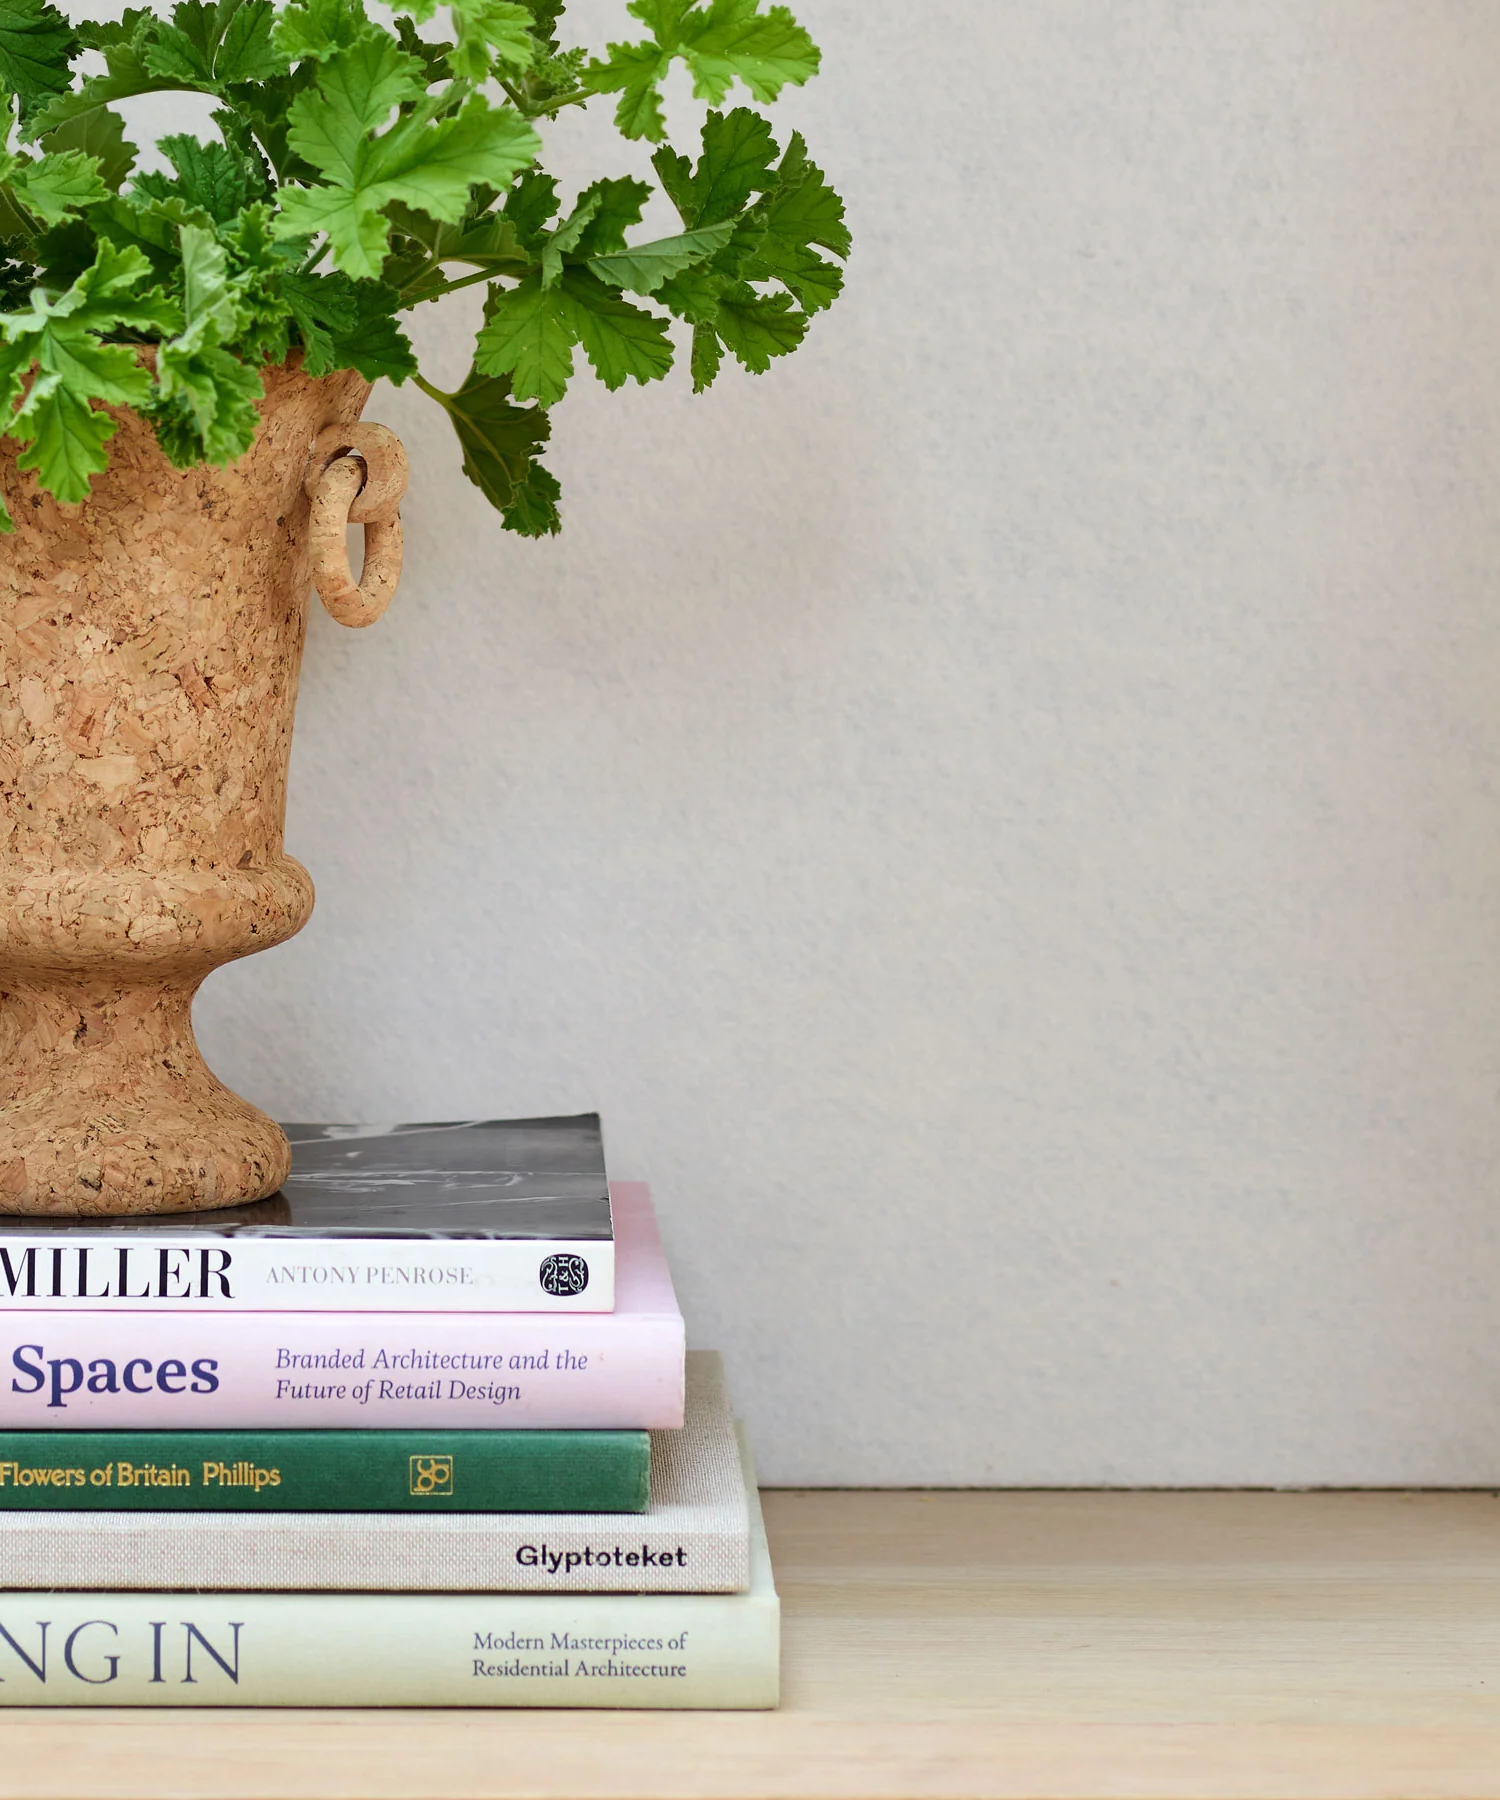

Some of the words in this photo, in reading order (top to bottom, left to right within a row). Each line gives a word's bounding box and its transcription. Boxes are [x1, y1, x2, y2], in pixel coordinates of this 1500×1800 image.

[266, 1266, 359, 1285] ANTONY
[367, 1266, 473, 1285] PENROSE
[275, 1348, 364, 1370] Branded
[372, 1348, 503, 1370] Architecture
[508, 1348, 550, 1370] and
[555, 1349, 588, 1371] the
[10, 1344, 219, 1407] Spaces
[275, 1380, 346, 1400] Future
[351, 1379, 375, 1404] of
[378, 1380, 442, 1400] Retail
[448, 1381, 521, 1405] Design
[90, 1462, 114, 1486] of
[117, 1462, 191, 1487] Britain
[202, 1462, 282, 1492] Phillips
[516, 1544, 688, 1574] Glyptoteket
[148, 1621, 245, 1685] IN
[473, 1632, 545, 1652] Modern
[550, 1632, 662, 1656] Masterpieces
[667, 1632, 688, 1652] of
[472, 1659, 569, 1678] Residential
[575, 1659, 687, 1679] Architecture
